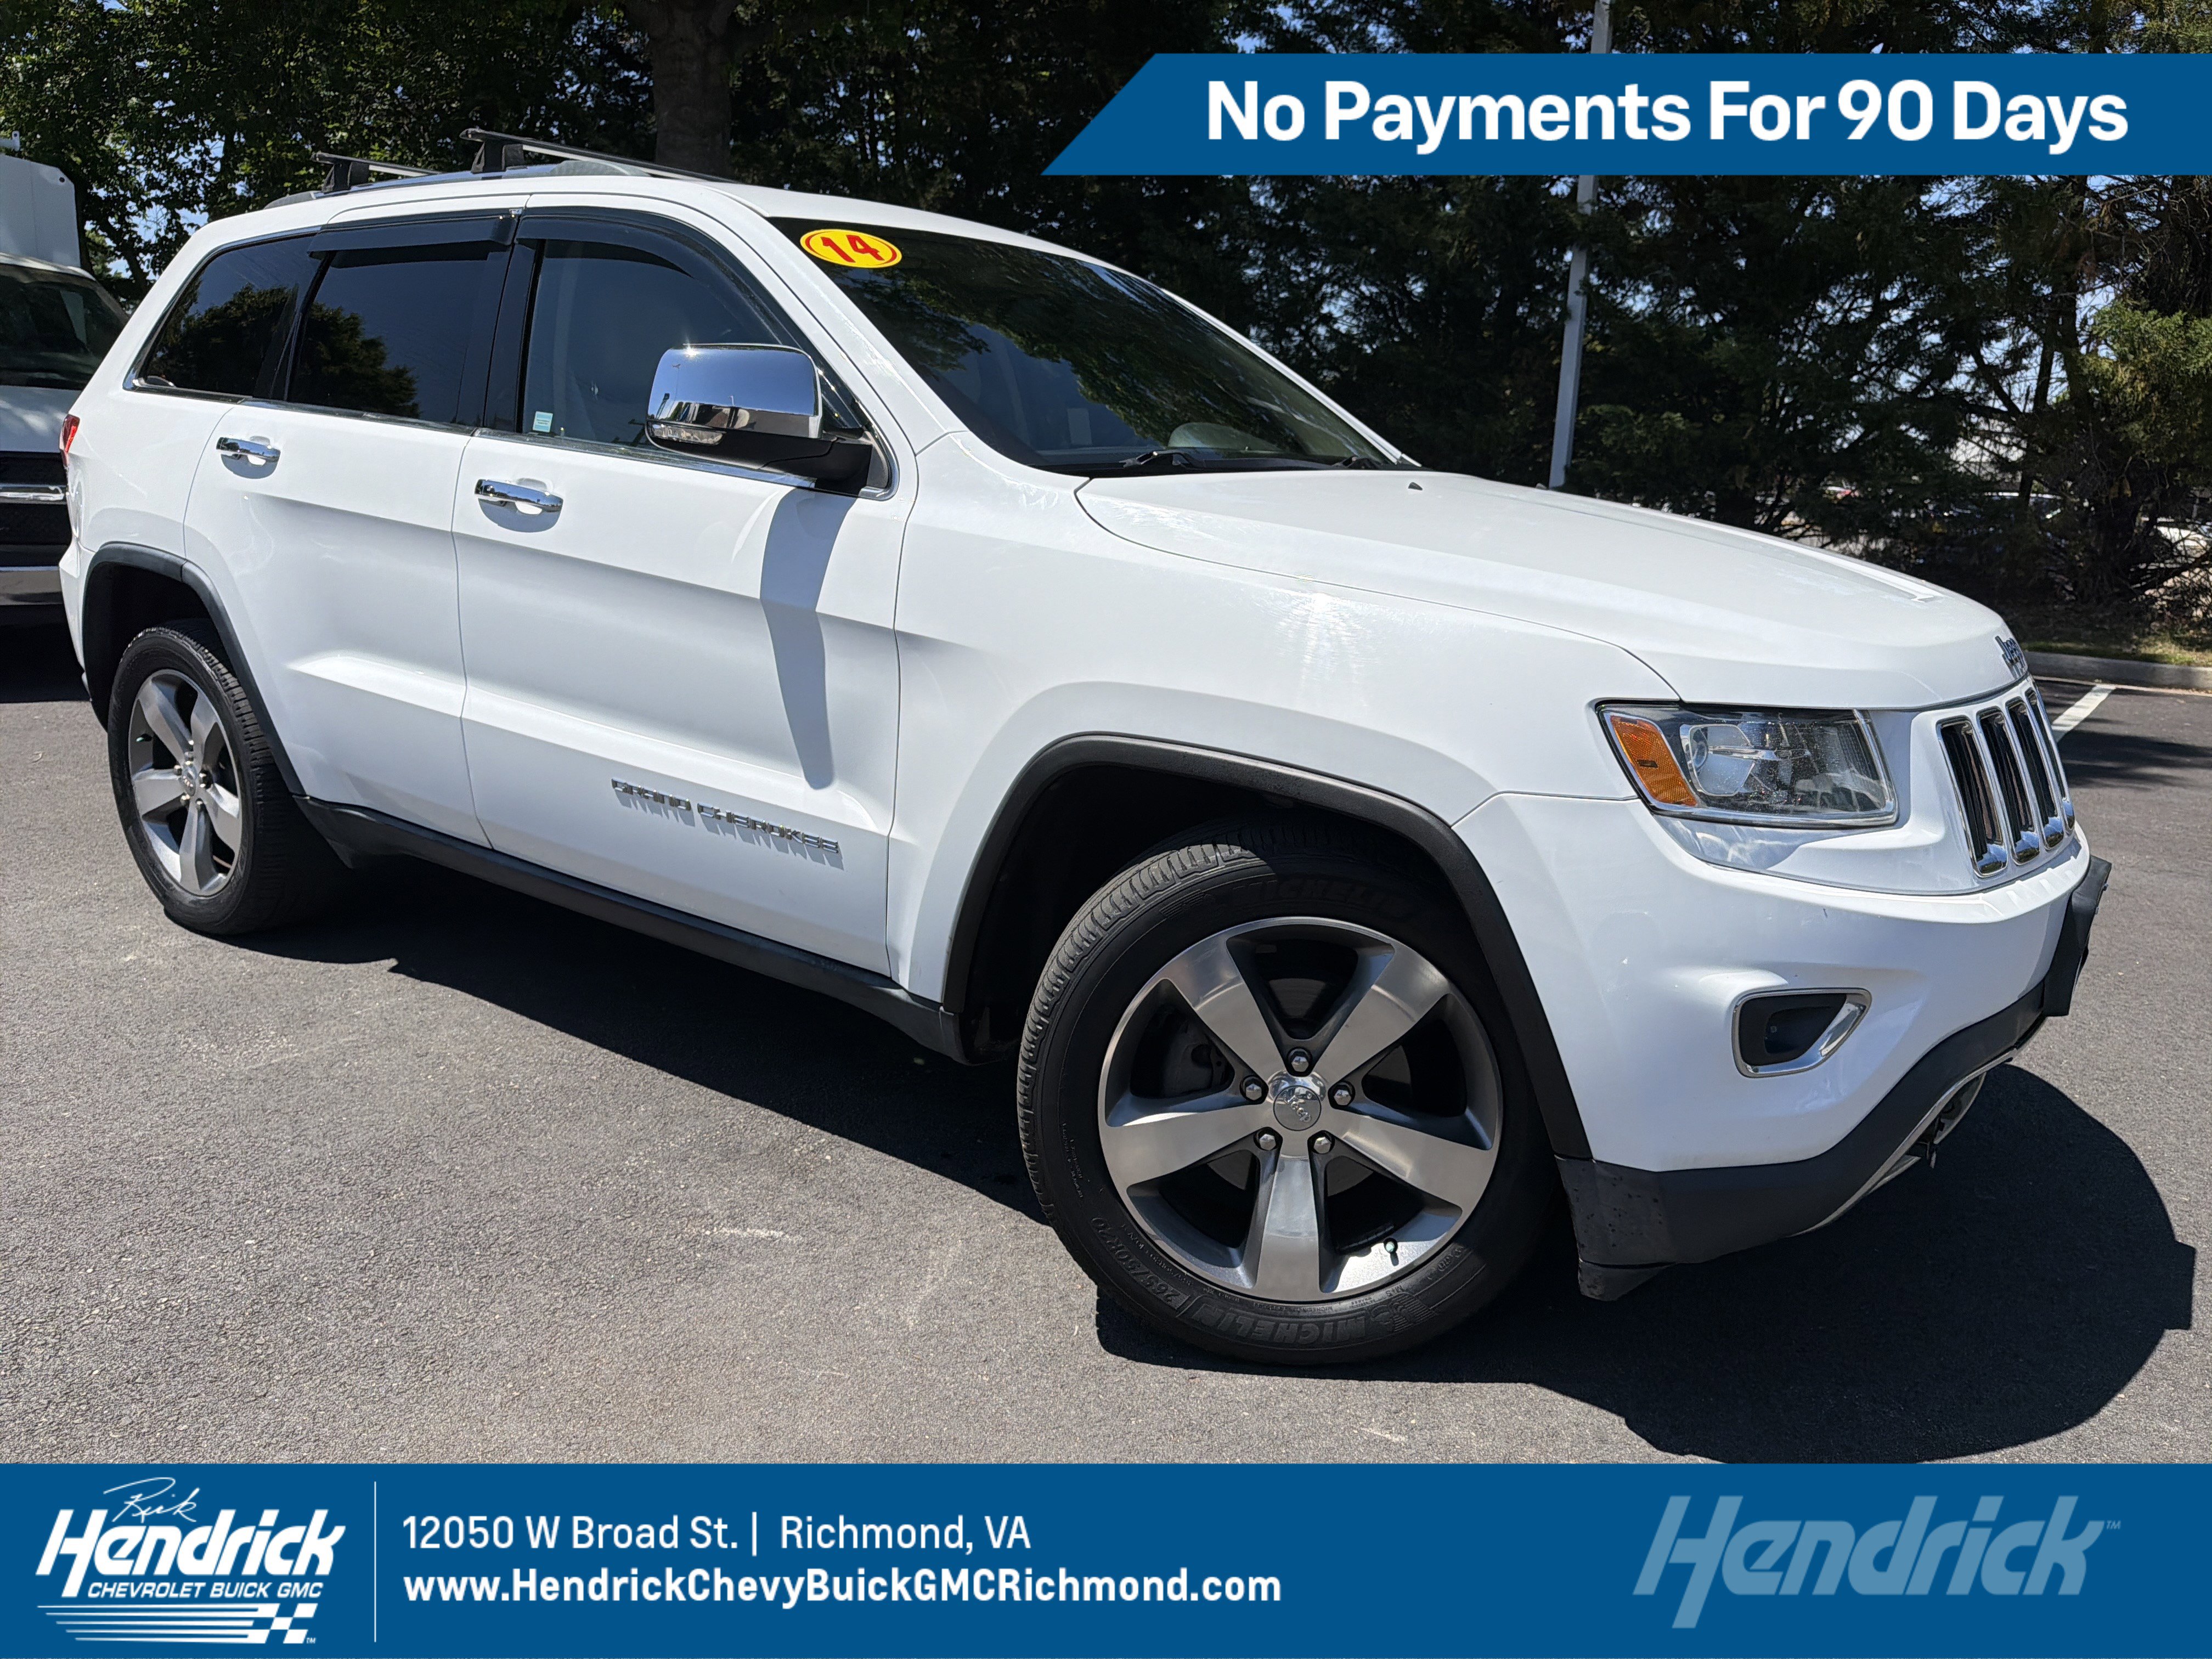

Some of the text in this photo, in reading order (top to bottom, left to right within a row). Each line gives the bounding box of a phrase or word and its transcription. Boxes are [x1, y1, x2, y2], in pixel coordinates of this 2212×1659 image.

[821, 234, 885, 263] 14
[611, 777, 839, 854] GRAND CHEROKEE
[1191, 1302, 1366, 1345] MICHELIN
